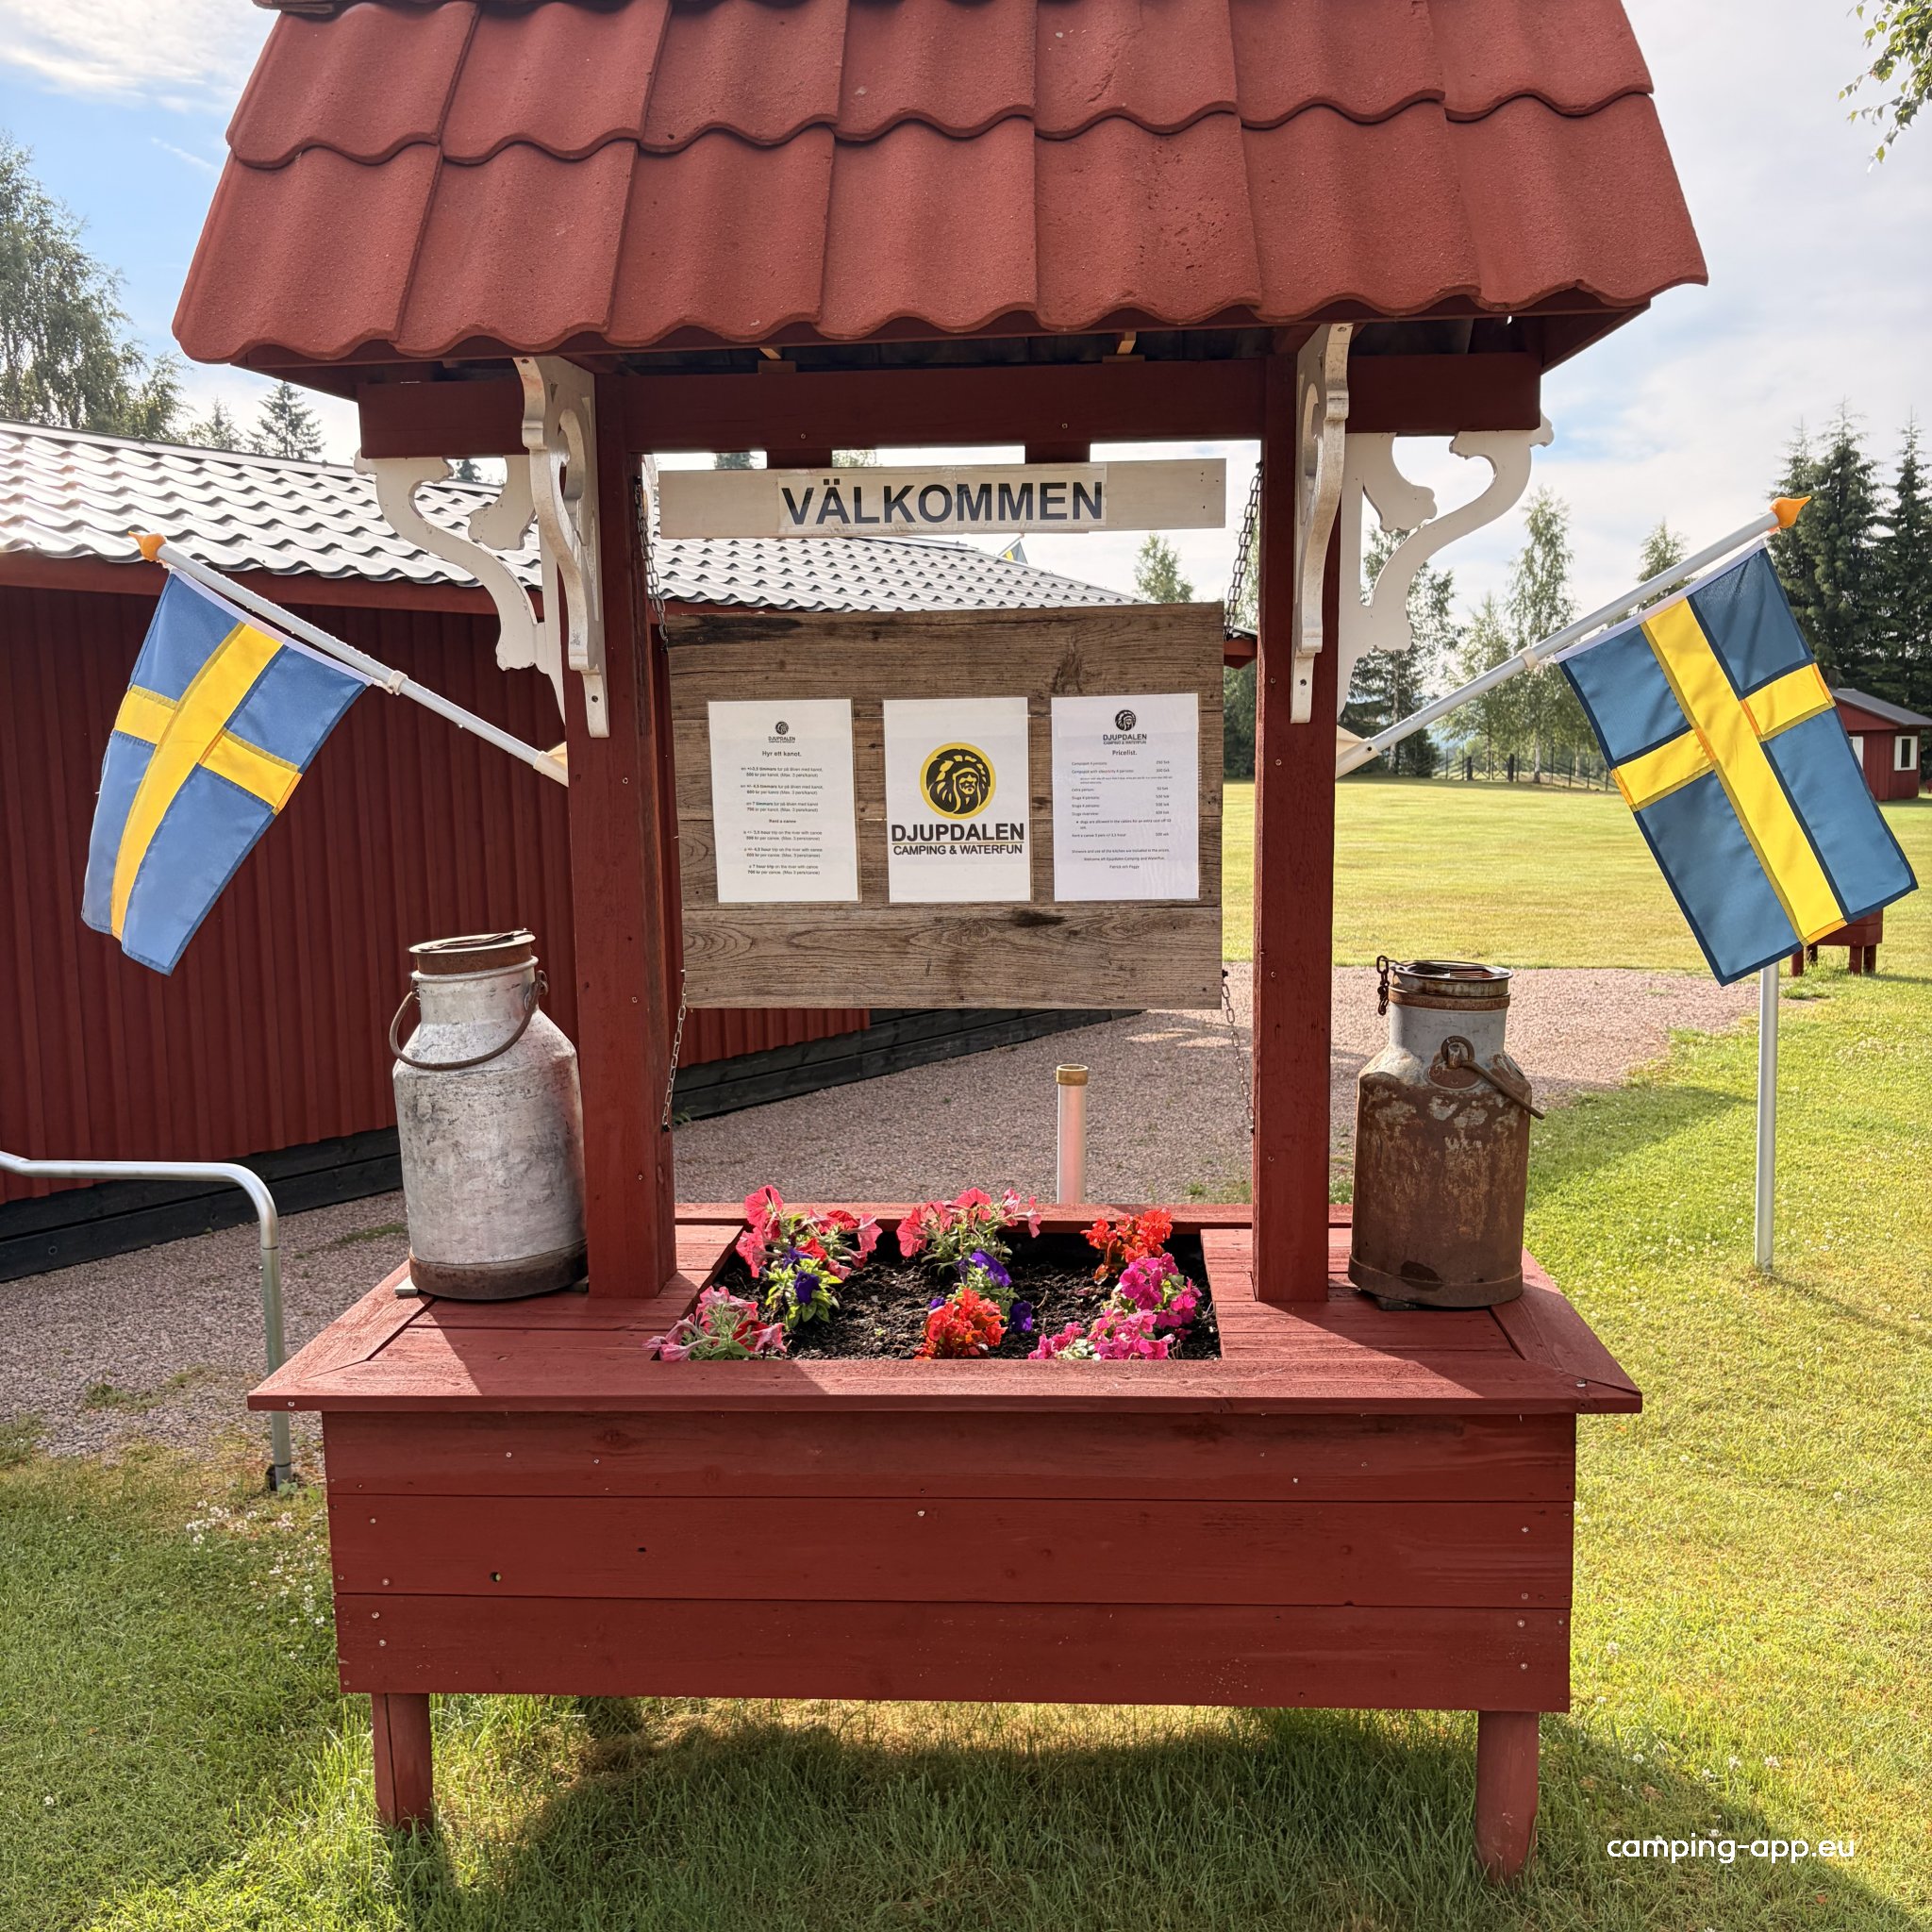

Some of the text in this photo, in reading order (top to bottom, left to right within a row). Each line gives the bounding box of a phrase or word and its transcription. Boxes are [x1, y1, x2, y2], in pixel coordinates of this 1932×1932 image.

[782, 478, 1103, 525] VÄLKOMMEN
[891, 823, 1024, 841] DJUPDALEN
[893, 844, 1023, 855] CAMPING & WATERFUN
